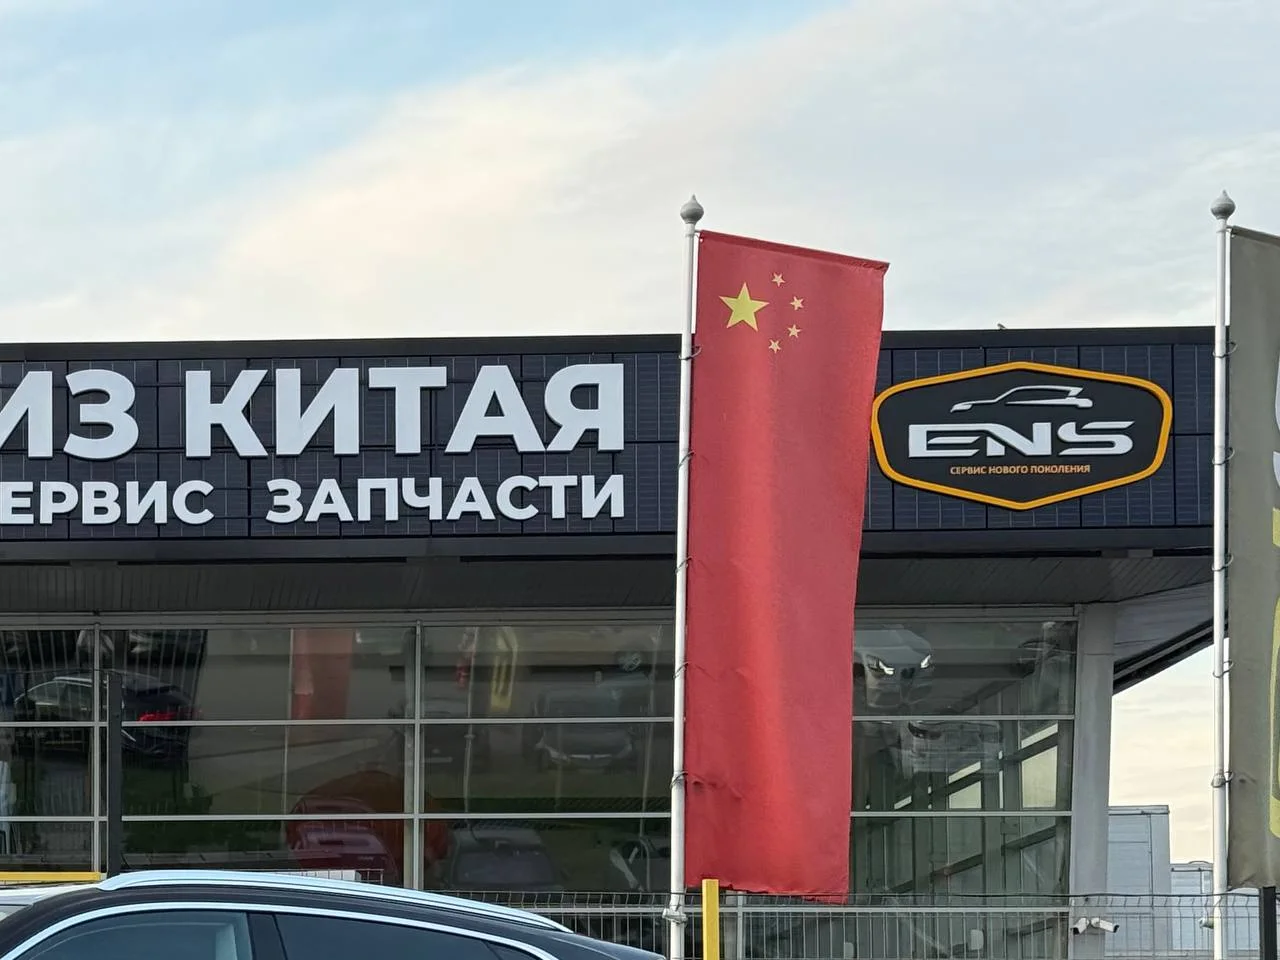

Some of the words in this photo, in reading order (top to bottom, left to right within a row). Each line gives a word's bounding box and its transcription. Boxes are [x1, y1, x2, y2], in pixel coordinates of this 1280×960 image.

[185, 364, 624, 457] КИТАЯ
[908, 421, 1135, 458] ENS
[950, 465, 987, 475] СЕРВИС
[988, 465, 1028, 474] НОВОГО
[1030, 464, 1091, 474] ПОКОЛЕНИЯ
[265, 474, 624, 523] ЗАПЧАСТИ
